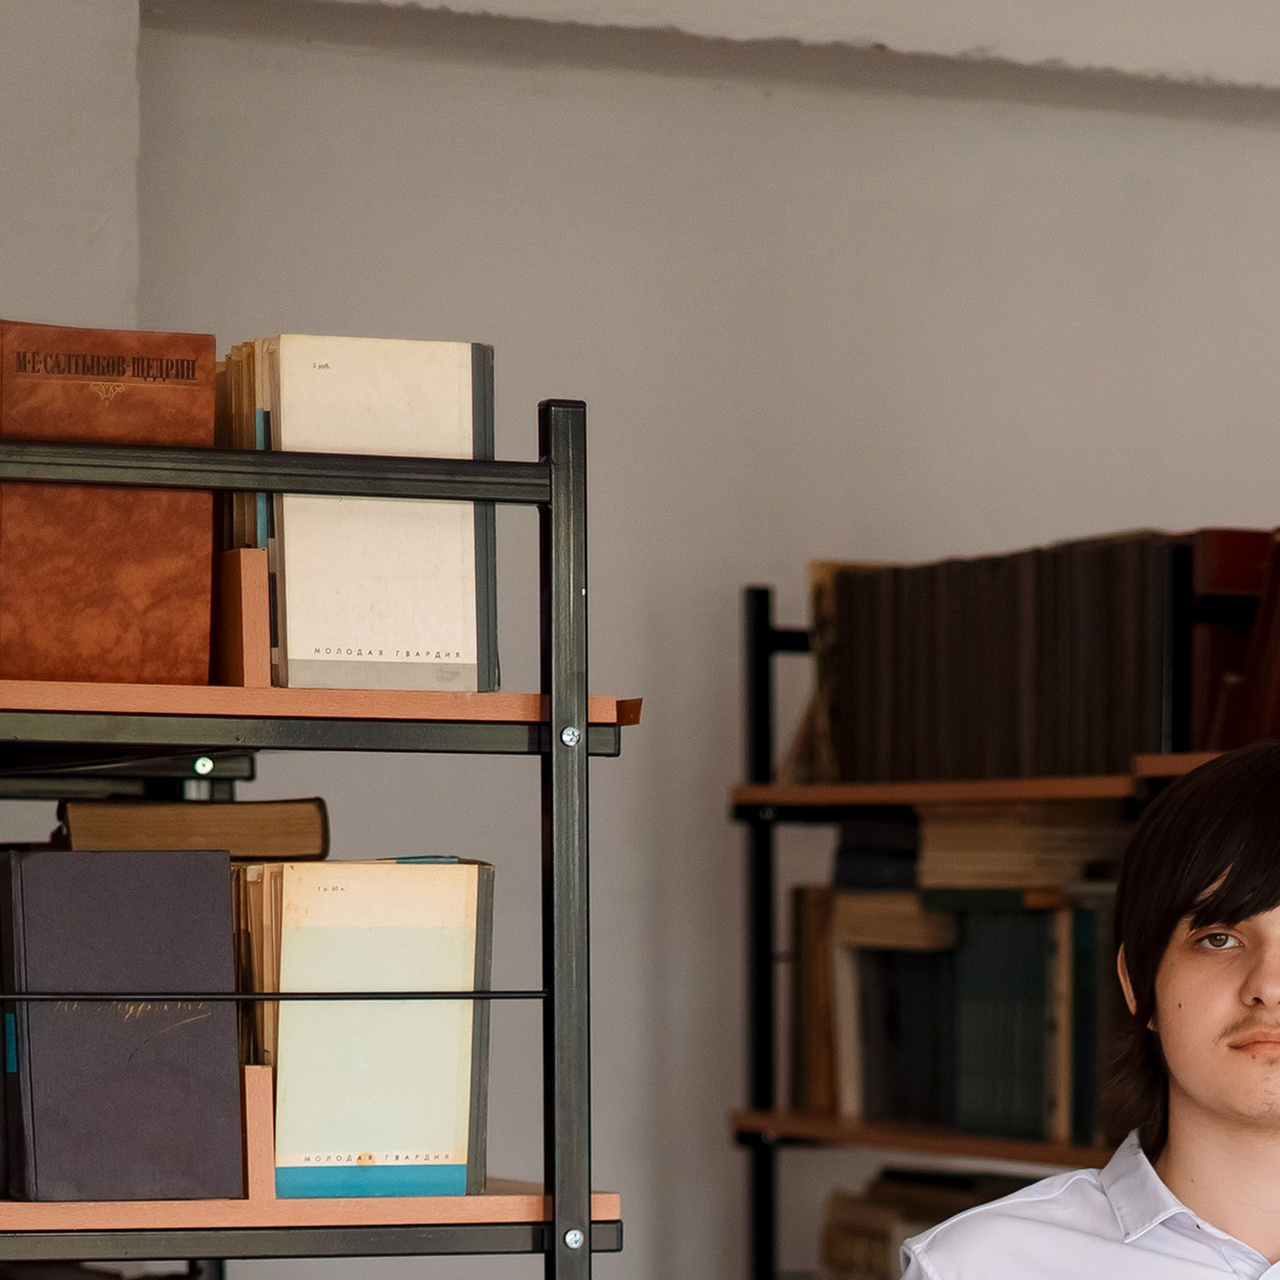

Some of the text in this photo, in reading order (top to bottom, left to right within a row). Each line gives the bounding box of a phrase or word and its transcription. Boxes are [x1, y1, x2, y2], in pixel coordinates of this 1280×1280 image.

[314, 647, 460, 659] МОЛОДАЯ ГВАРДИЯ
[304, 1153, 450, 1162] МОЛОДАЯ ГВАРДИЯ
